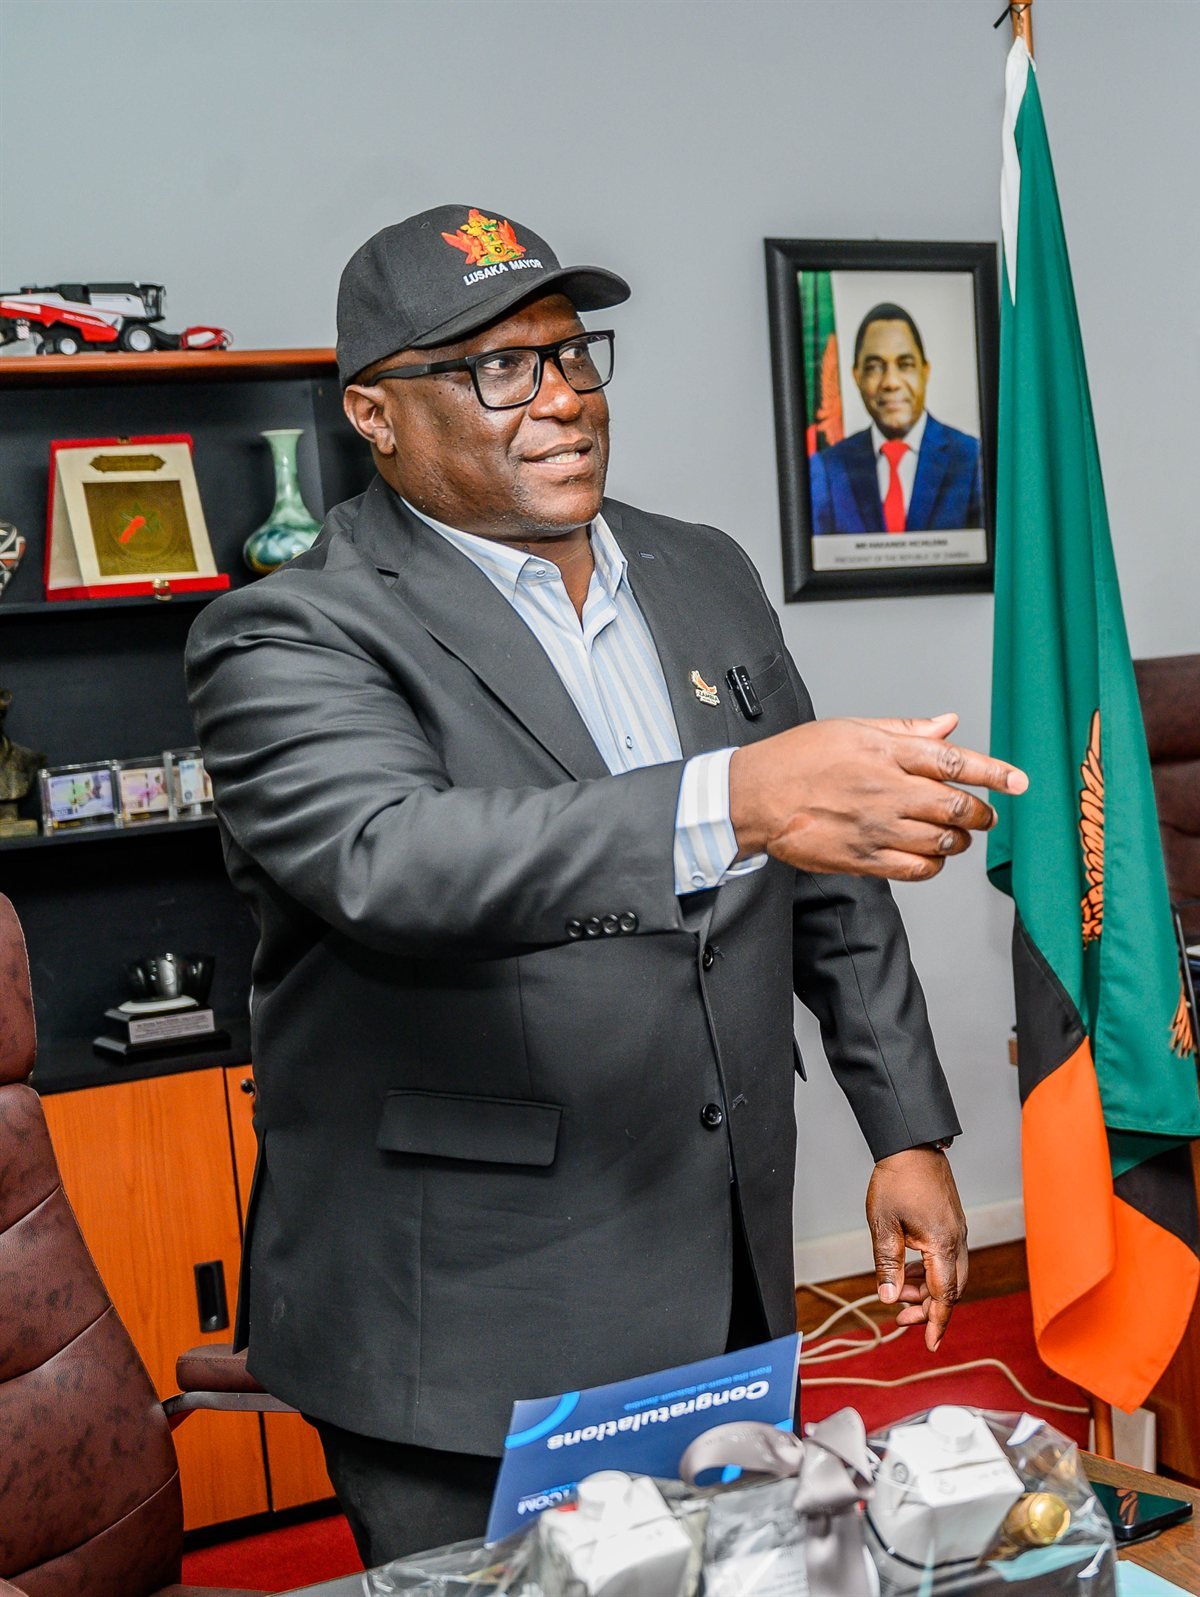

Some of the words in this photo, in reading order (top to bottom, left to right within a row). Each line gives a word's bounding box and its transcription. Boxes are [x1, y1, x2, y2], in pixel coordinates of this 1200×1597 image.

[463, 263, 509, 286] LUSAKA
[509, 259, 543, 271] MAYOR
[546, 1380, 769, 1450] Congratulations
